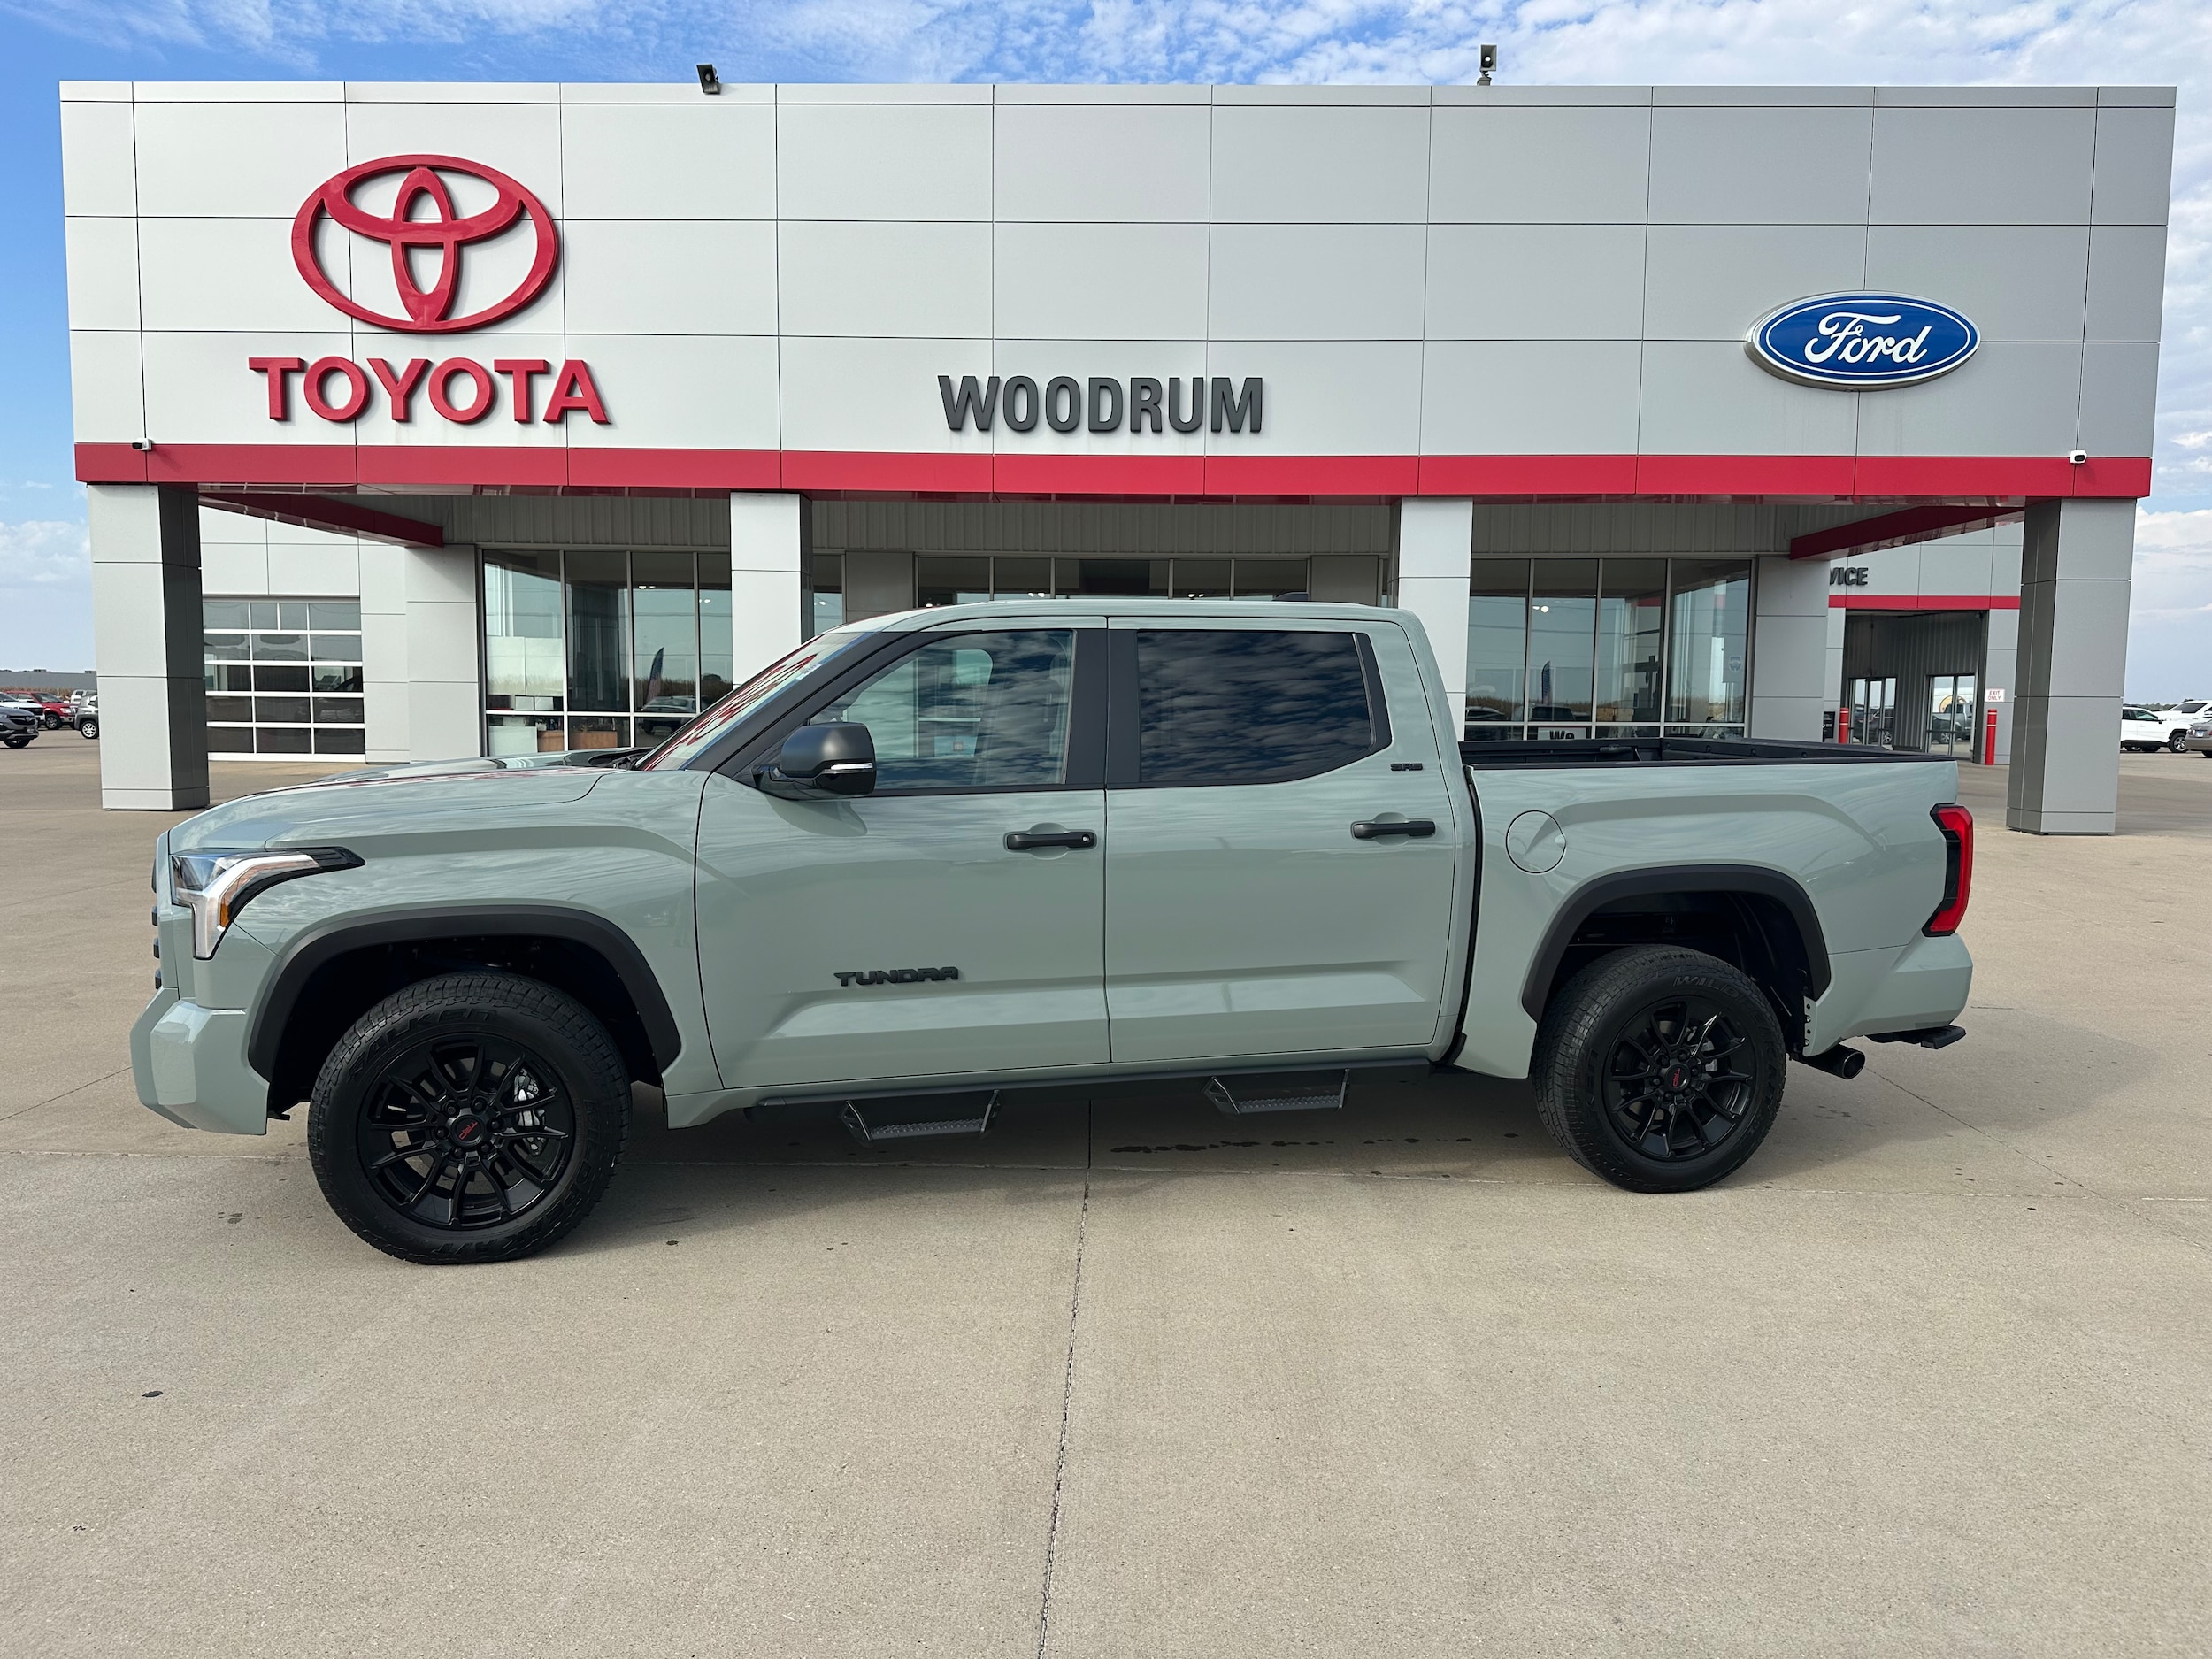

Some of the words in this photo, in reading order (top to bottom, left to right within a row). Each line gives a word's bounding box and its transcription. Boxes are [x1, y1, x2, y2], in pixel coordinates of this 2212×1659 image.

[1804, 311, 1932, 364] Ford
[248, 355, 612, 425] TOYOTA
[937, 375, 1263, 434] WOODRUM
[1390, 763, 1423, 772] SR5
[833, 966, 959, 987] TUNDRA
[1672, 1067, 1681, 1087] TRD
[458, 1121, 479, 1141] TRD
